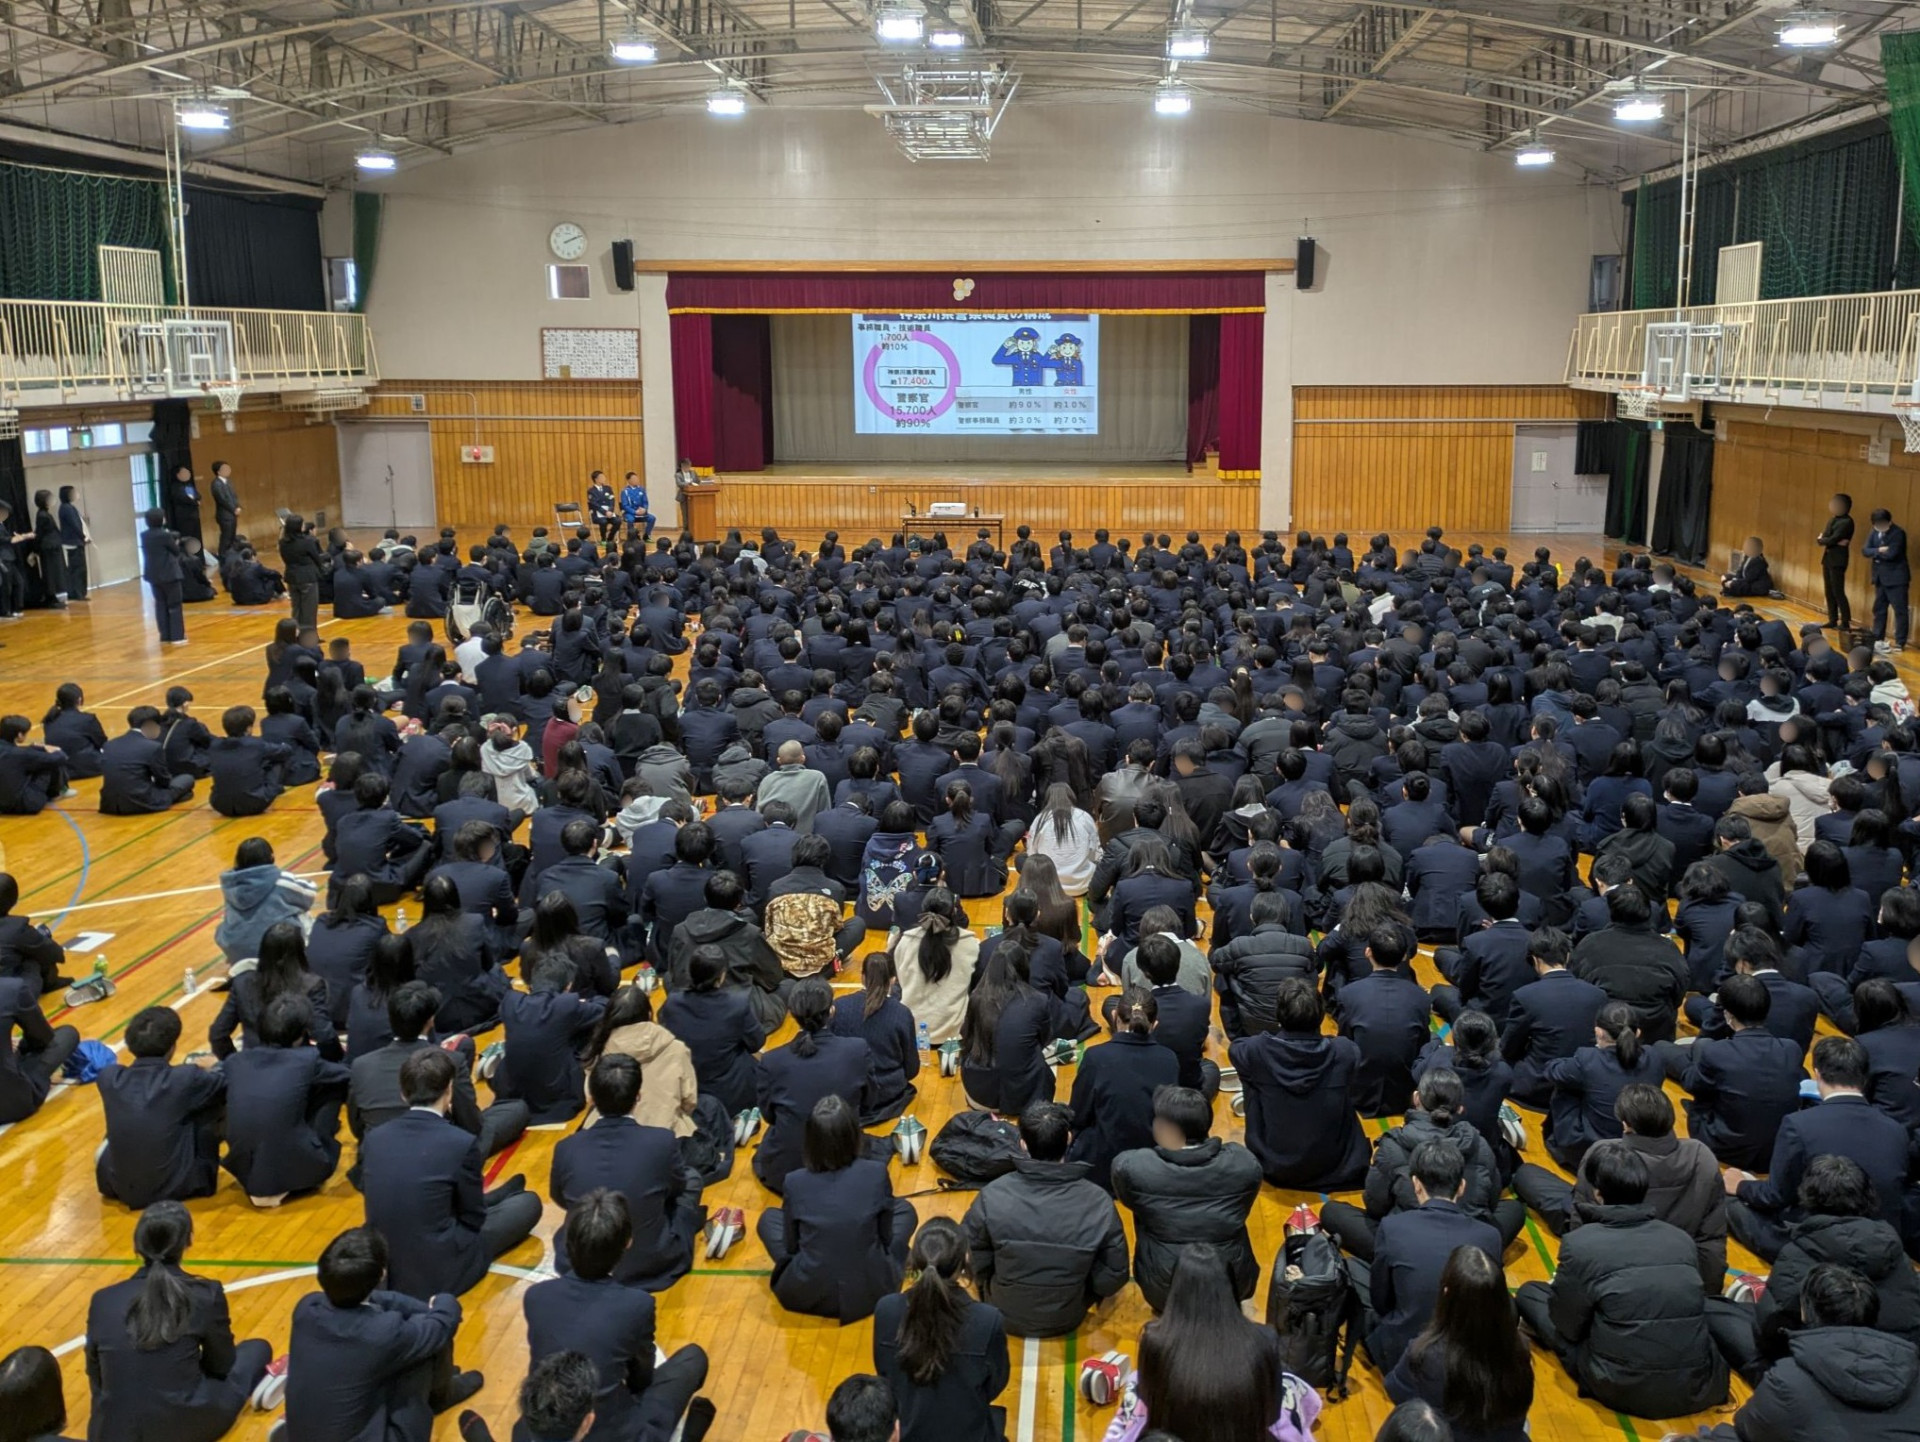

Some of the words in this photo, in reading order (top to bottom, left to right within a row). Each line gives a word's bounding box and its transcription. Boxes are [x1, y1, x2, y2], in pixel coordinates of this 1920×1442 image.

[897, 392, 930, 404] 警察官
[895, 418, 931, 429] 約90%
